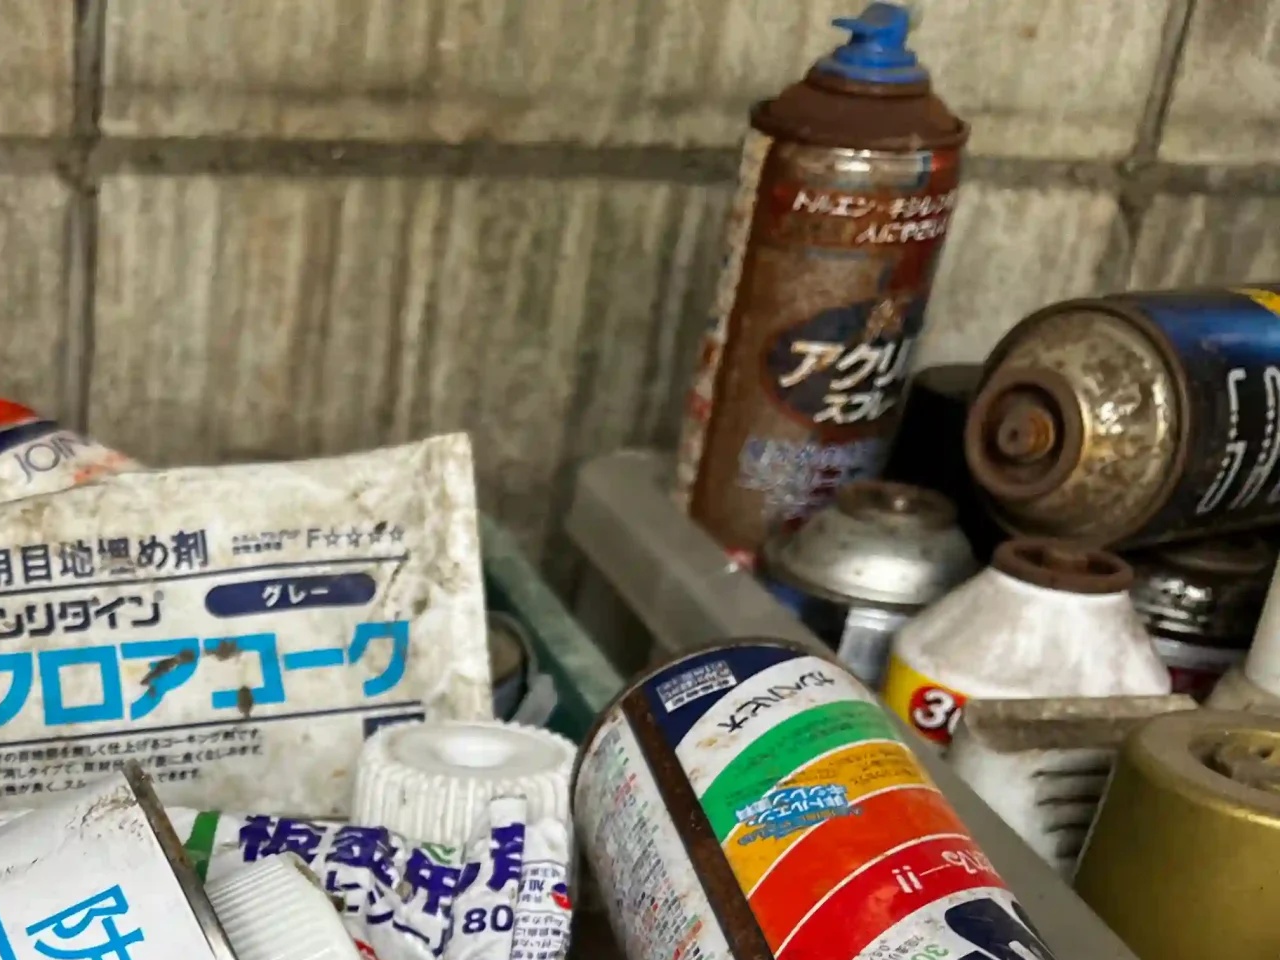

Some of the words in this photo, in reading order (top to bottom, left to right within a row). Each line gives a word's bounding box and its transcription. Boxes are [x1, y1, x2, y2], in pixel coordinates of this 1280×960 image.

[261, 578, 330, 608] グレー
[463, 903, 514, 936] 80
